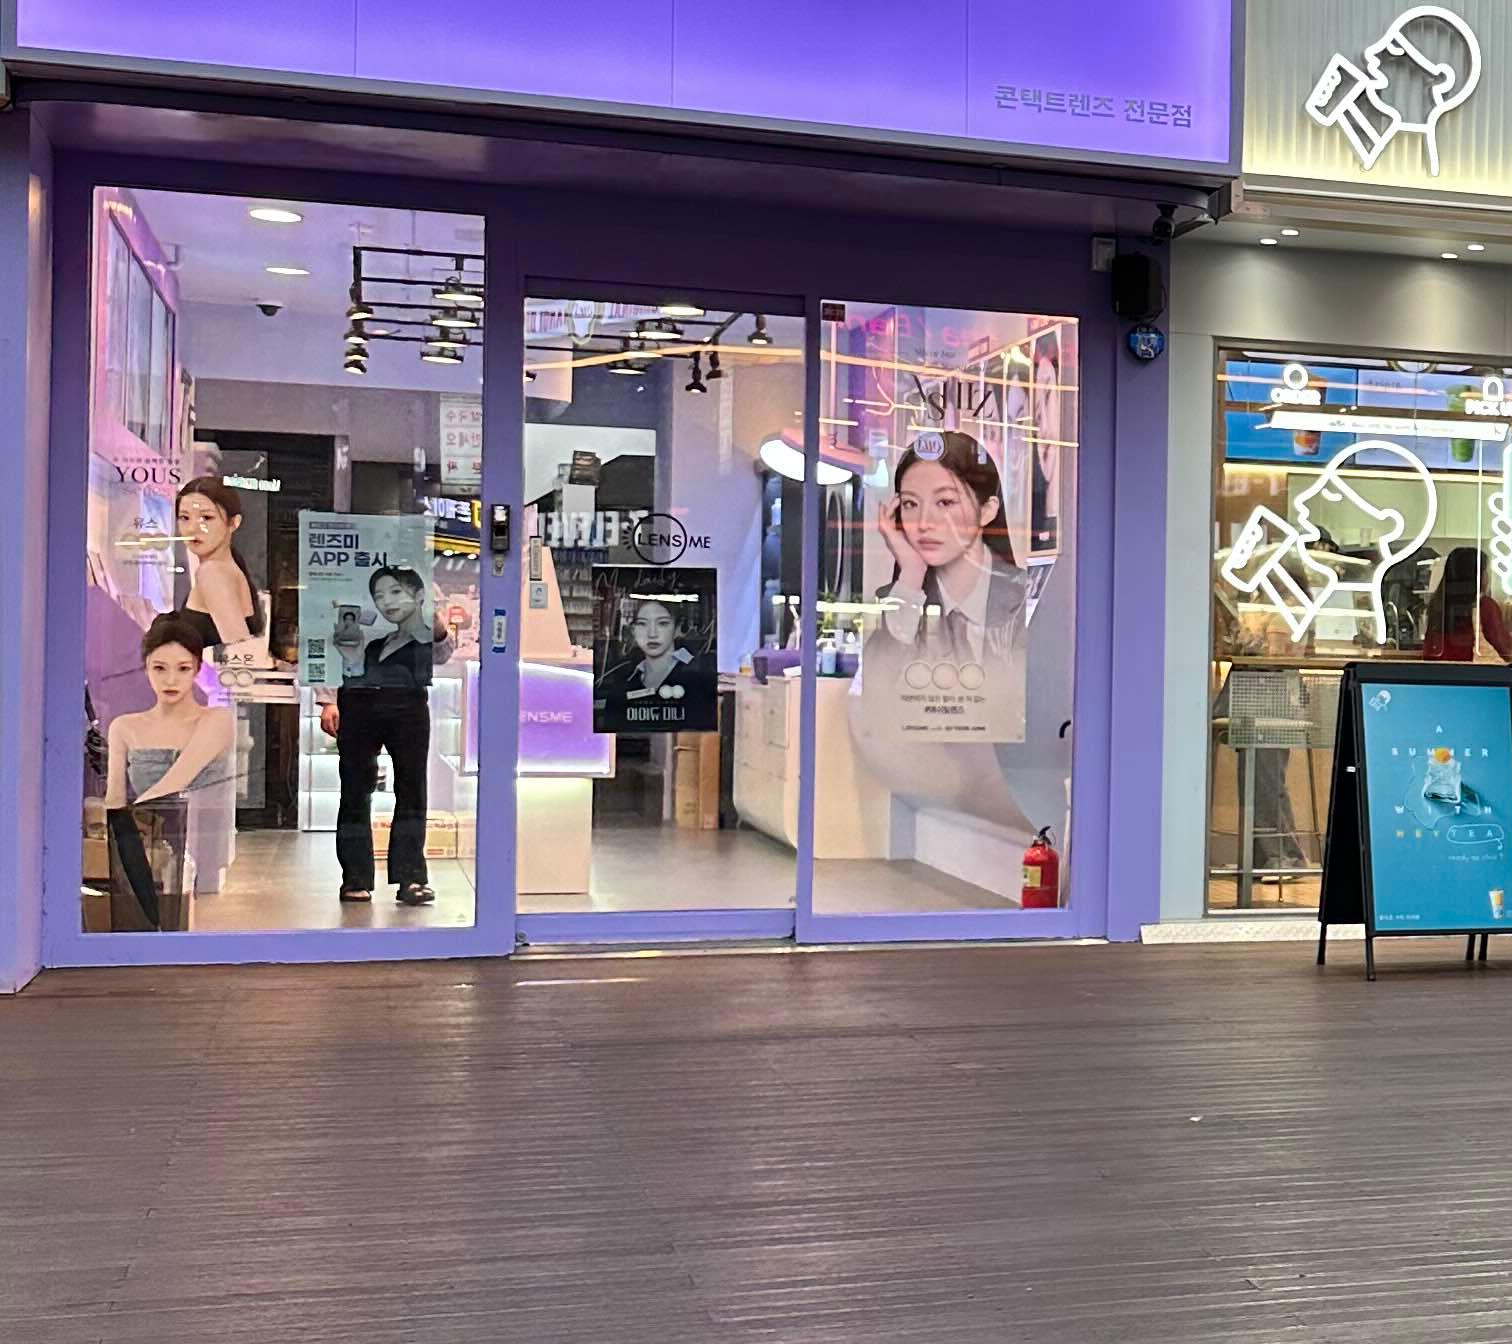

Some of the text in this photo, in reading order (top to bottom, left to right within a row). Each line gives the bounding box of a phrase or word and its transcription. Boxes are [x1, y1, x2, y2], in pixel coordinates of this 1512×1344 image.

[995, 85, 1192, 129] 콘택트렌즈 전문점
[114, 466, 182, 484] YOUS
[309, 533, 359, 549] 렌즈미
[637, 532, 711, 549] LENS ME
[308, 551, 387, 568] APP 출시
[1436, 725, 1443, 733] A
[1394, 805, 1492, 814] WITH
